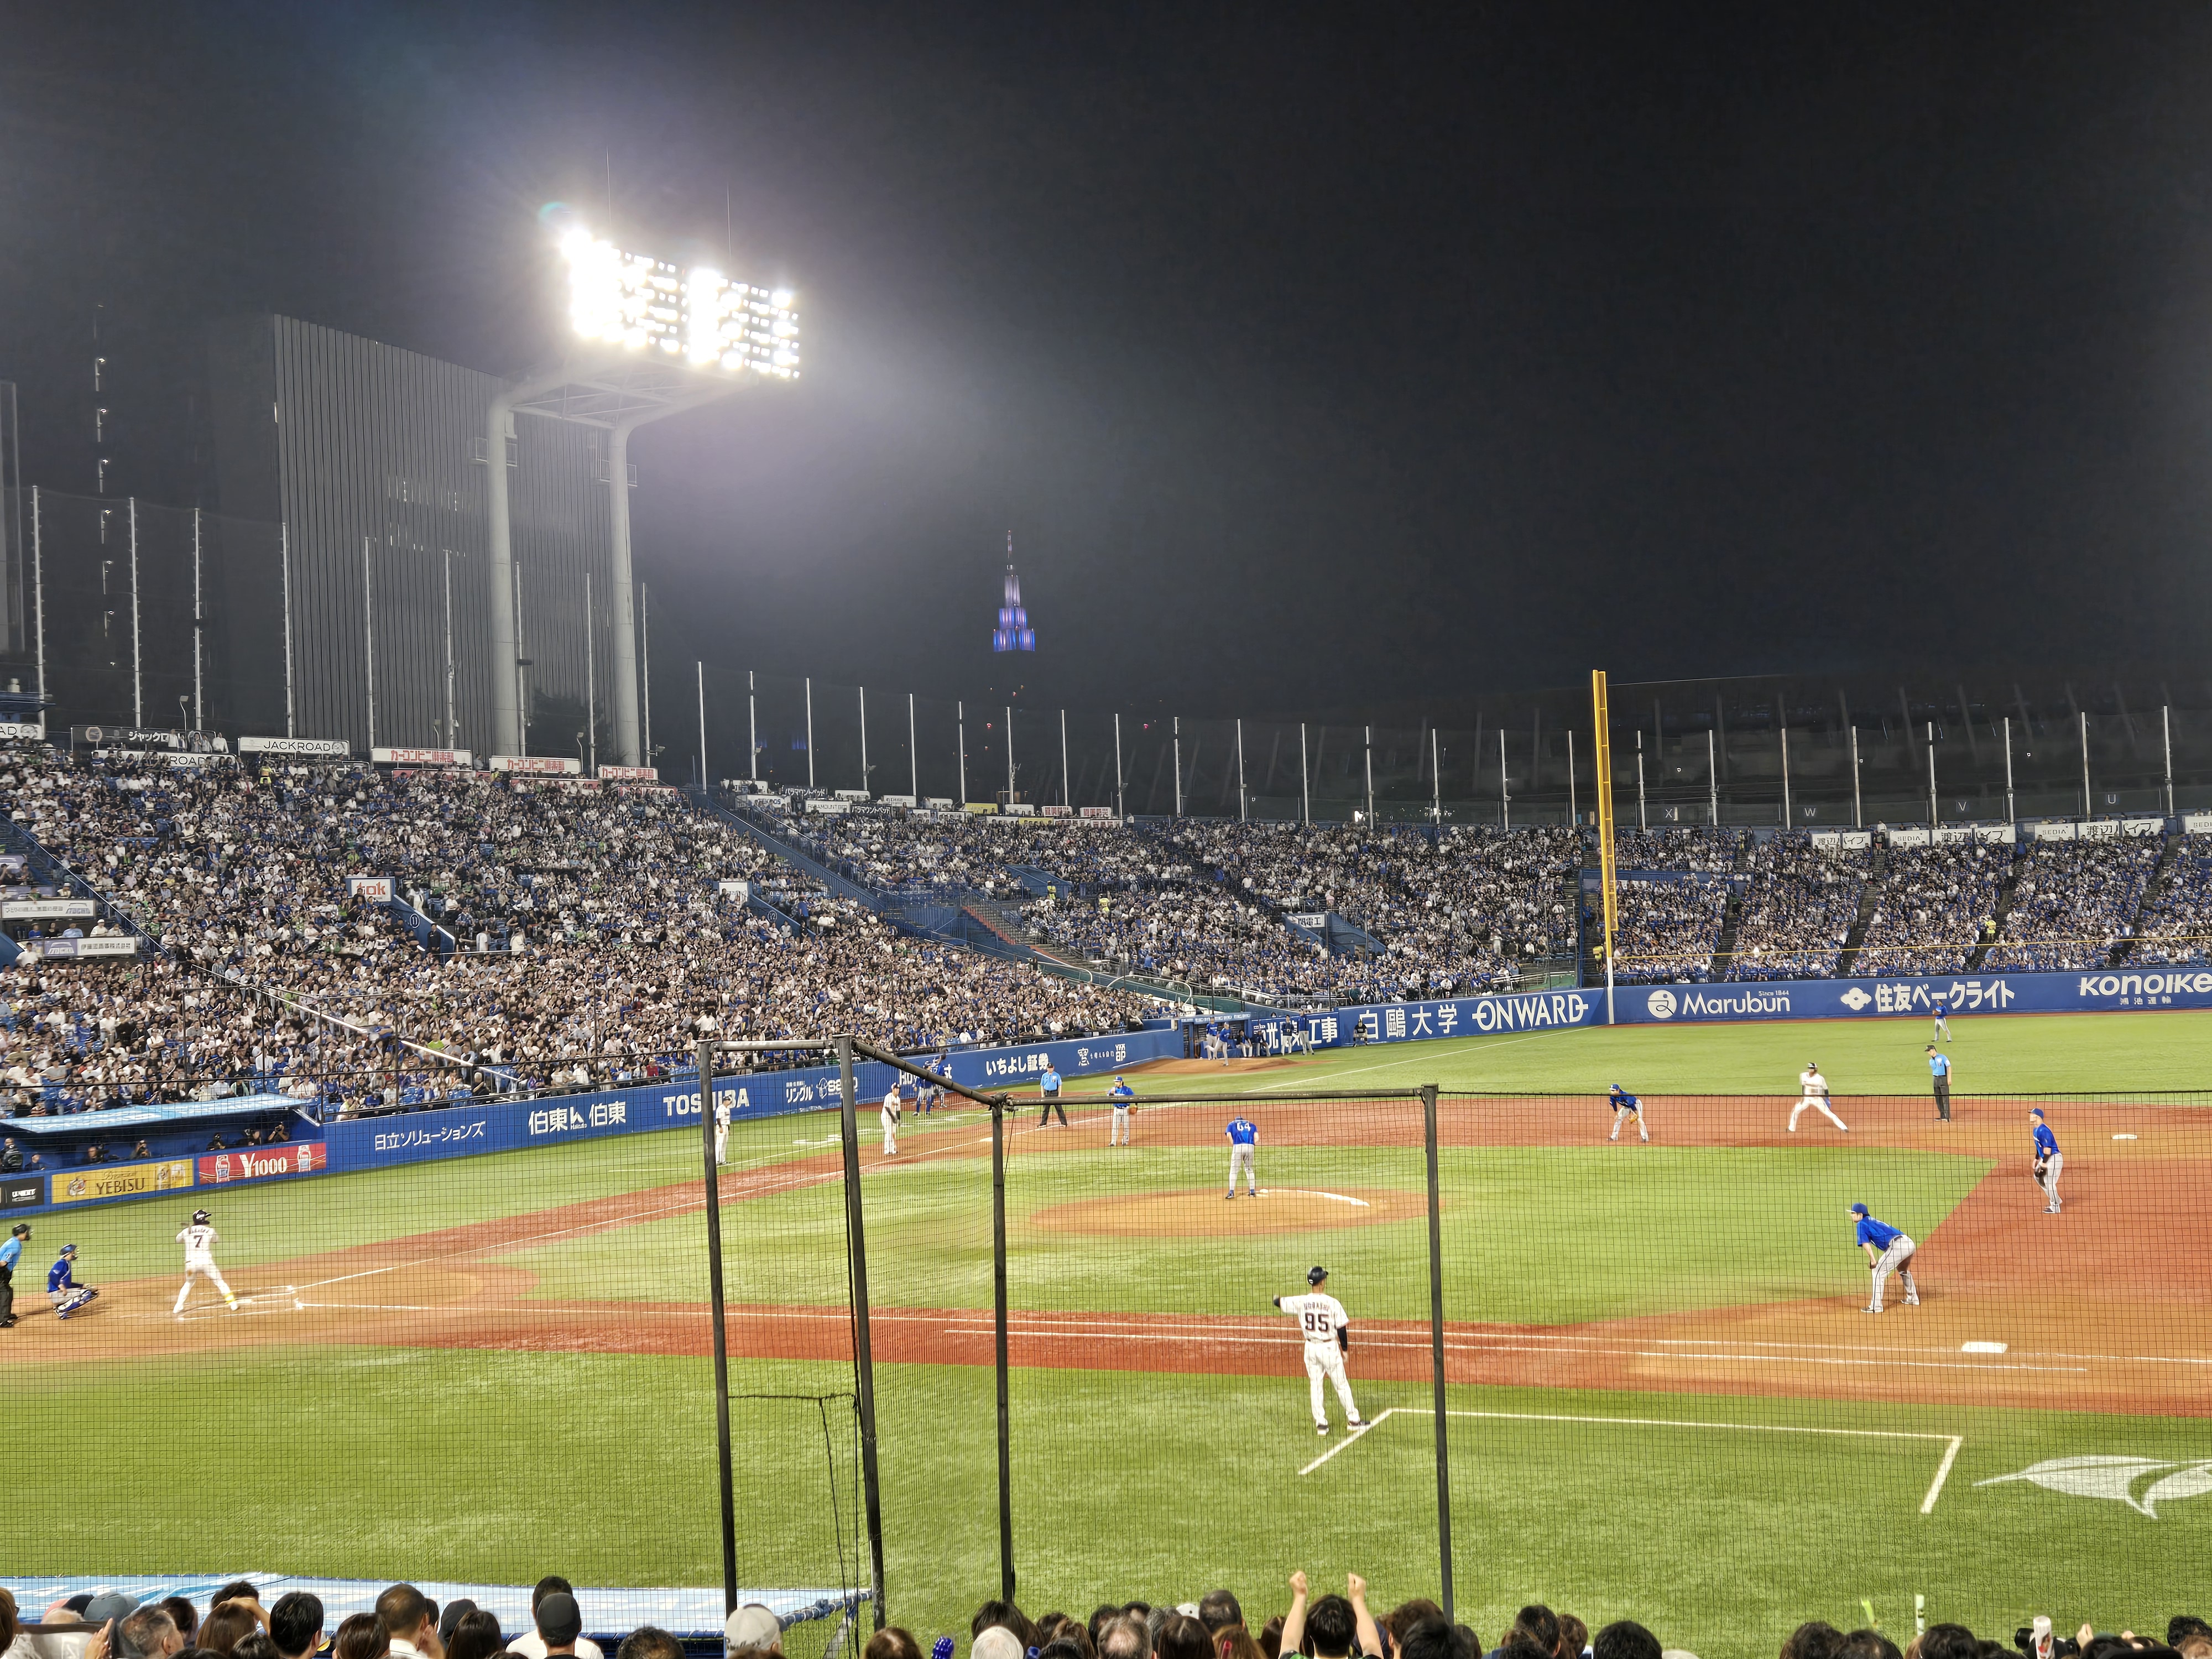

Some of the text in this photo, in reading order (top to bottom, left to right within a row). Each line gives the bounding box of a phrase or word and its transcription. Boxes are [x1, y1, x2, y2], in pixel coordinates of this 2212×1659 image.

[264, 740, 331, 752] JACKROAD
[1958, 801, 1967, 811] V
[2107, 794, 2116, 804] U
[1804, 807, 1816, 817] W
[1682, 991, 1791, 1015] Marubun
[1875, 979, 2015, 1013] 住友ベークライト
[1472, 994, 1589, 1031] ONWARD
[986, 1052, 1050, 1076] いちよし証券
[786, 1084, 813, 1103] リングル
[528, 1107, 568, 1135] 伯東
[589, 1100, 626, 1128] 伯東
[375, 1120, 486, 1151] 日立ソリューションズ
[239, 1152, 288, 1178] Y1000
[96, 1177, 145, 1195] YEBISU
[193, 1234, 204, 1248] 7
[1305, 1312, 1329, 1332] 95
